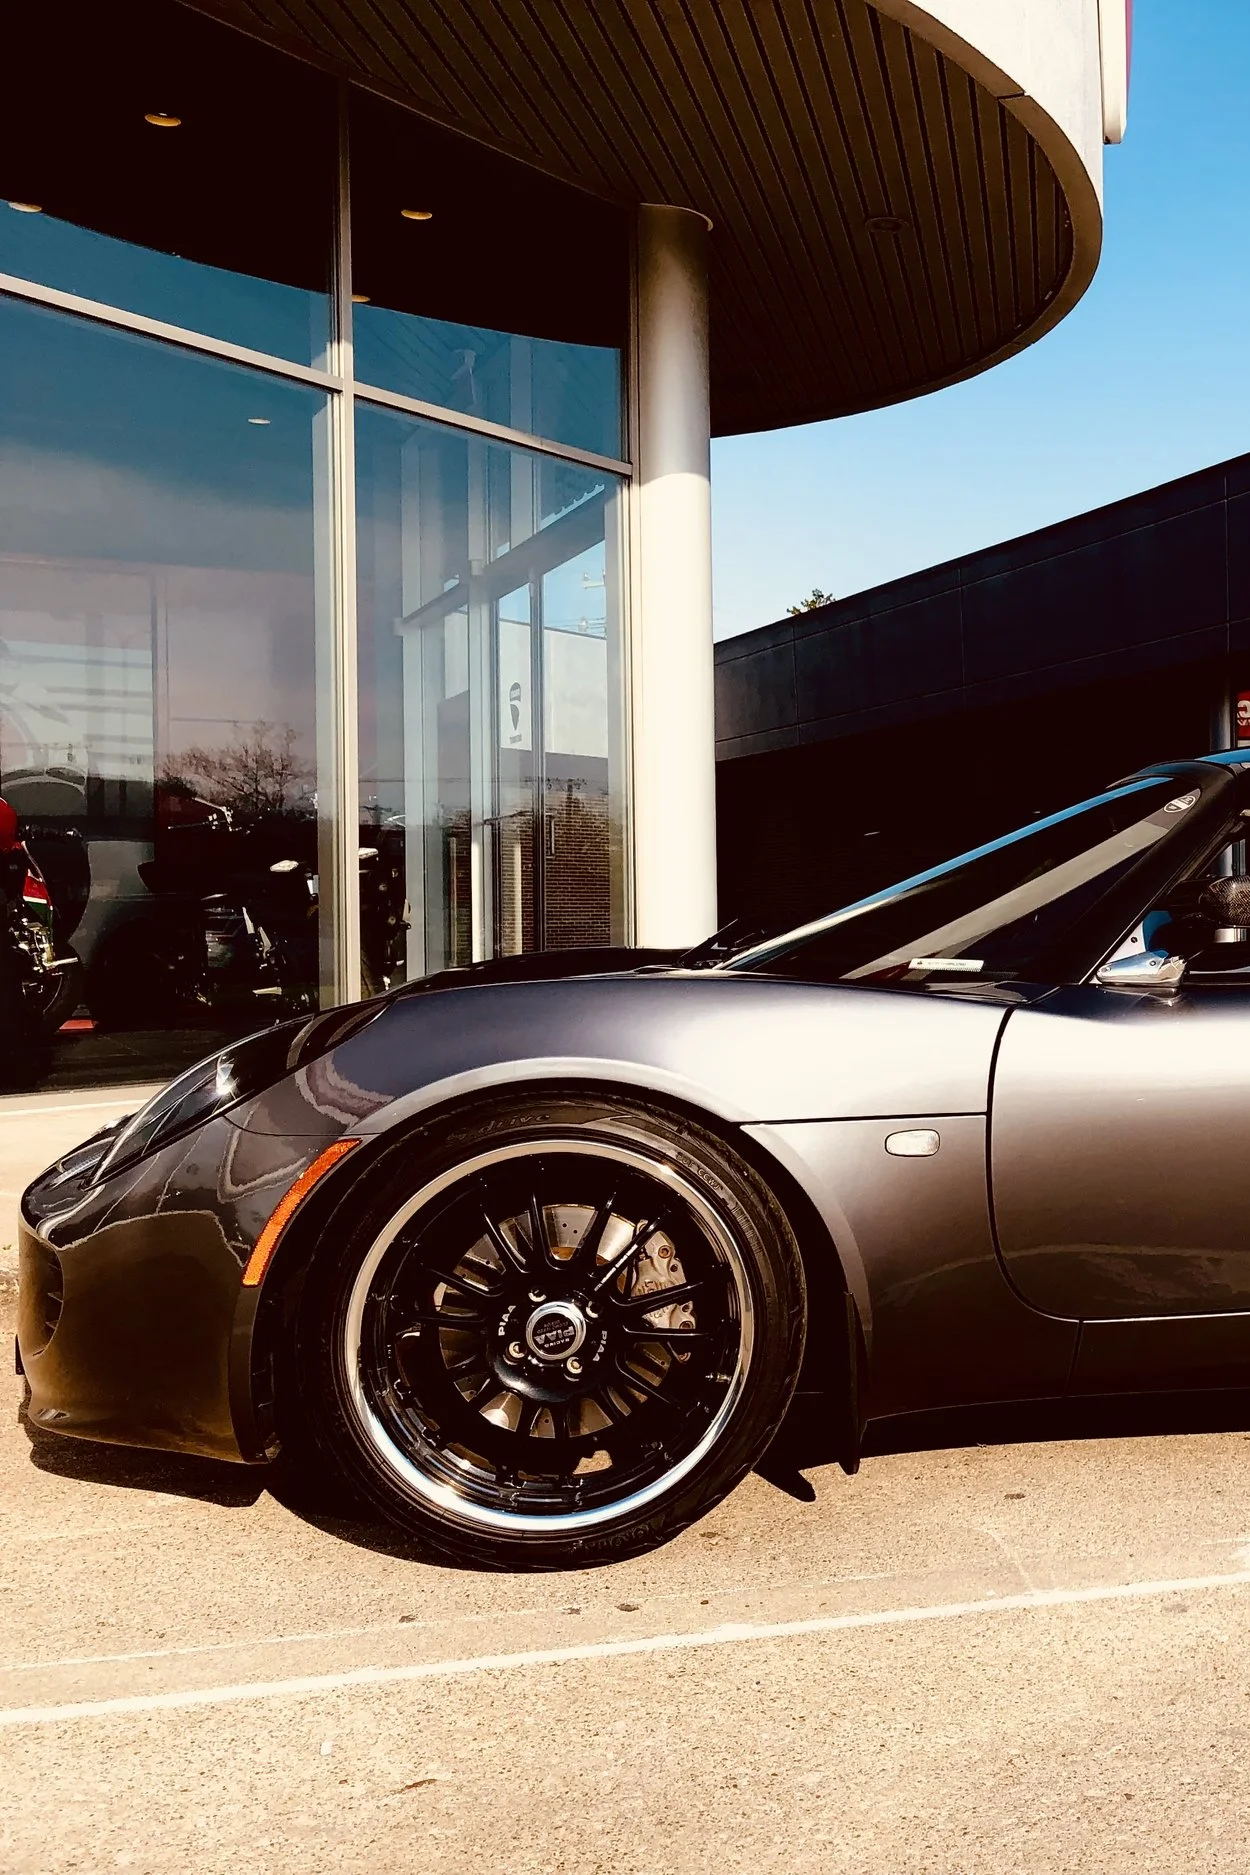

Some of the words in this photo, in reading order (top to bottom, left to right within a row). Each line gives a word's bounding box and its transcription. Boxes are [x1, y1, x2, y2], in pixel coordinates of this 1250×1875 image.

[498, 1305, 516, 1336] PIAA
[533, 1326, 575, 1344] PIAA
[592, 1330, 608, 1361] PIAA
